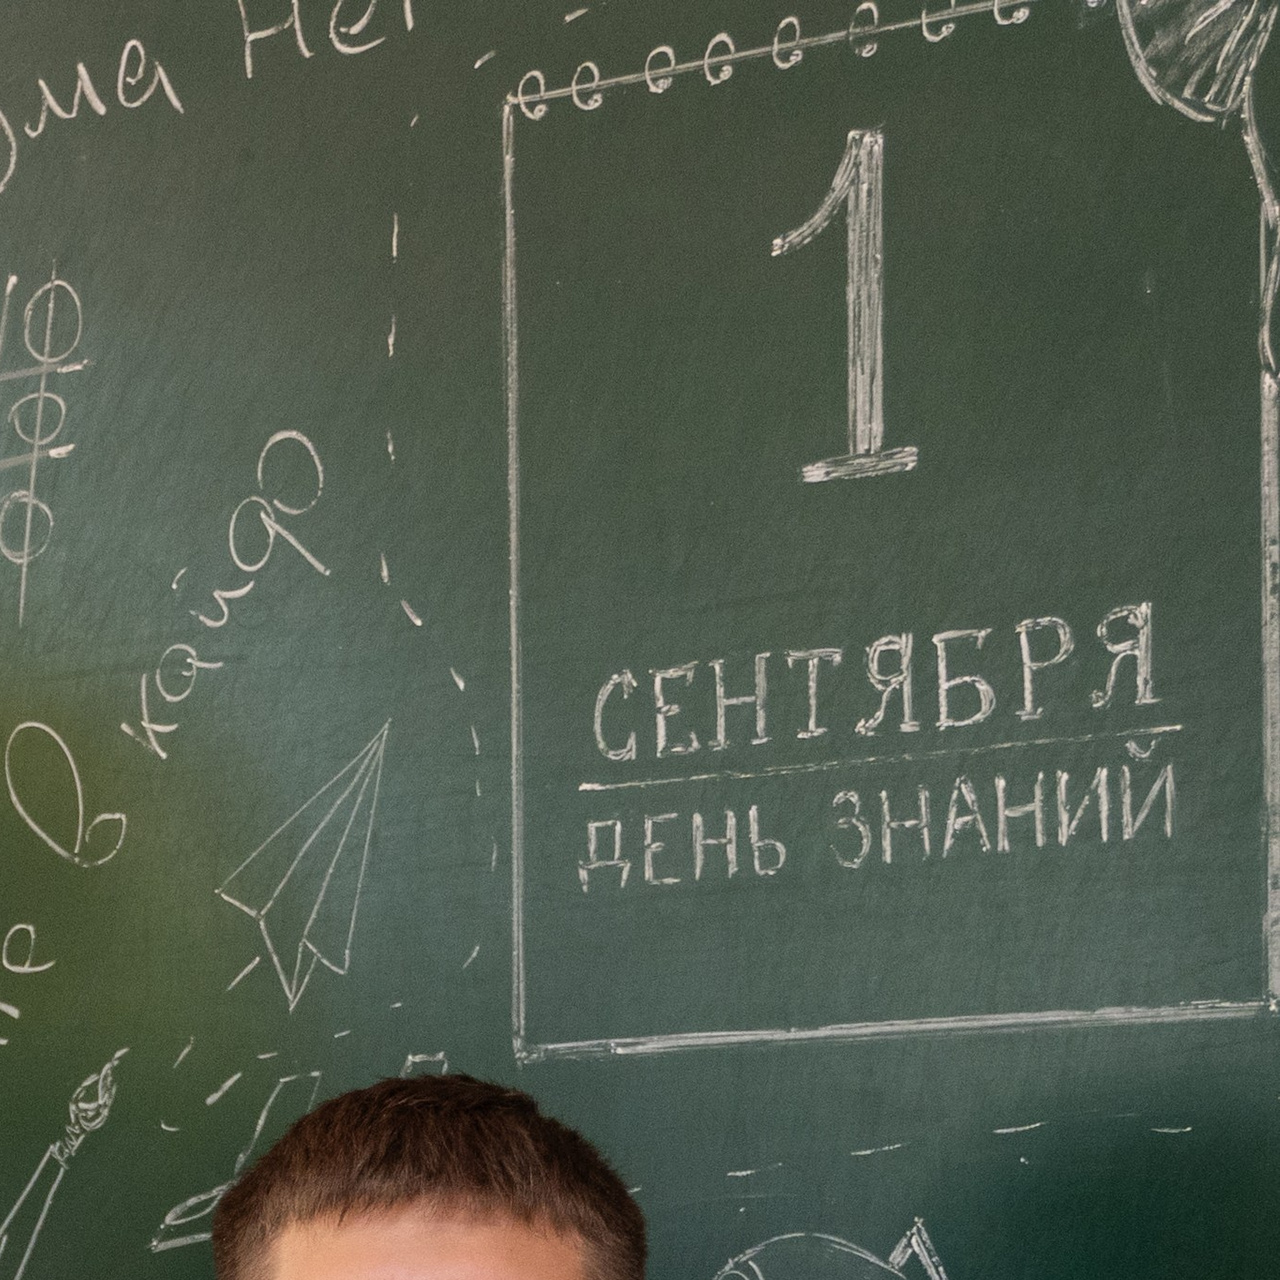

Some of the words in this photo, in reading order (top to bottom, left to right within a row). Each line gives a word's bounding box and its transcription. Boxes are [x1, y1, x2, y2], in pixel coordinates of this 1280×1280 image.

[770, 127, 918, 482] 1
[594, 601, 1160, 763] СЕНТЯБРЯ
[577, 803, 788, 893] ДЕНЬ
[830, 737, 1179, 870] ЗНАНИЙ
